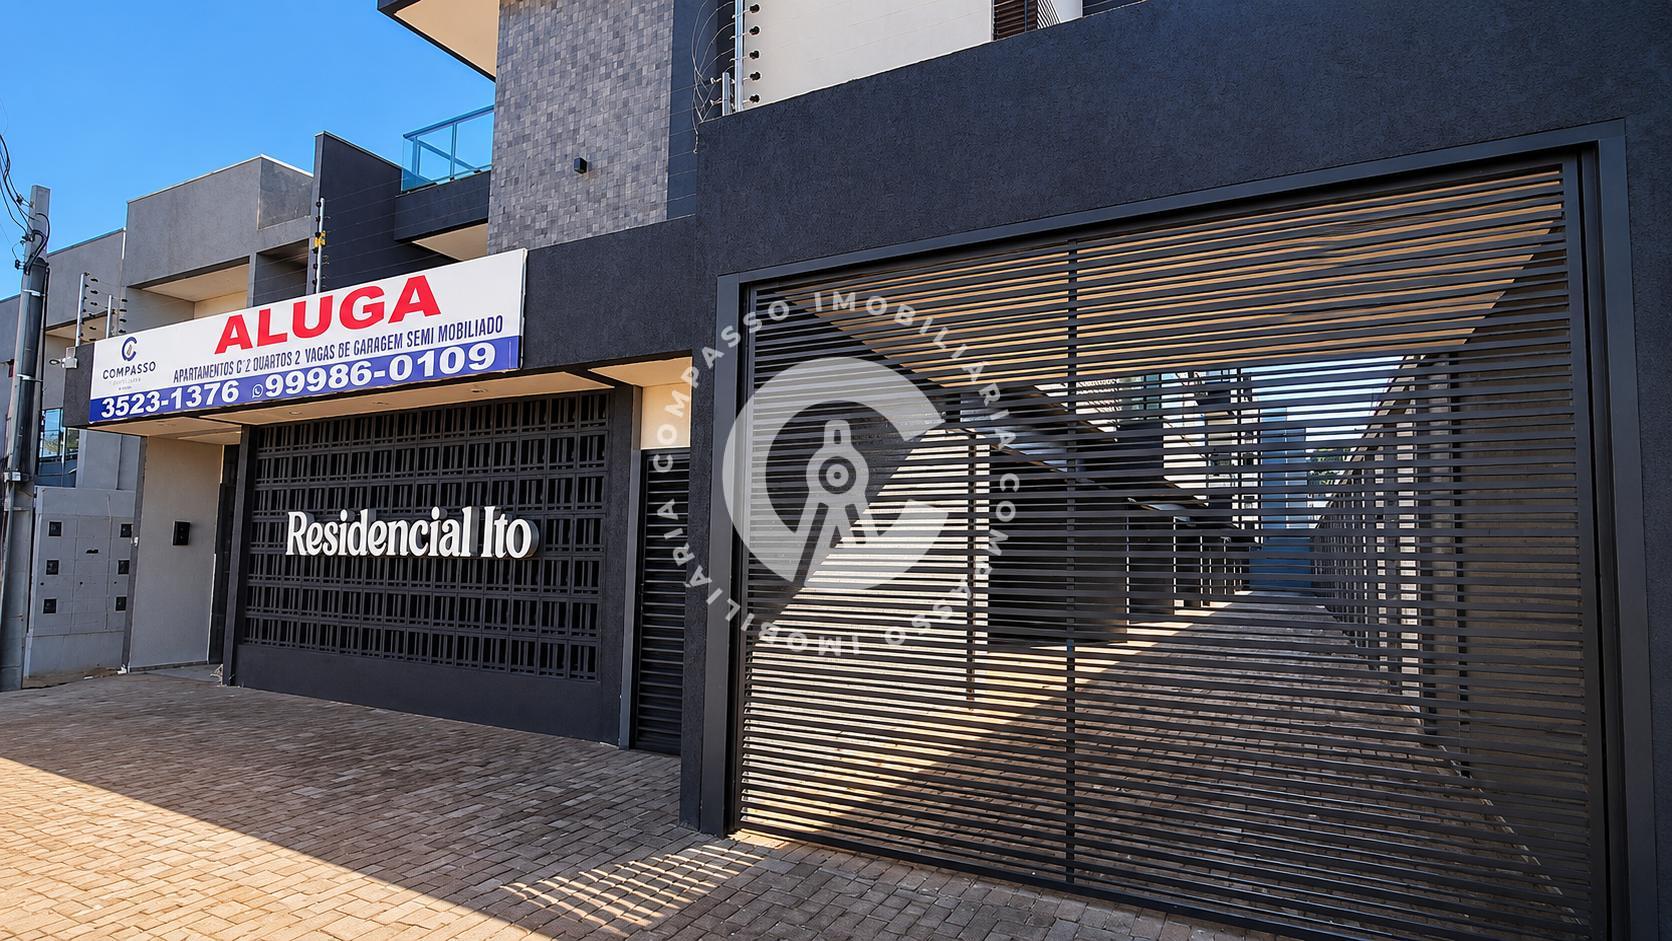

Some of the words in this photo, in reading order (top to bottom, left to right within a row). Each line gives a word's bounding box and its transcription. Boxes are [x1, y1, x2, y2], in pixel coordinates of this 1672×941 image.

[214, 274, 441, 355] ALUGA
[101, 380, 240, 419] 3523-1376
[265, 342, 496, 397] 99986-0109
[102, 361, 156, 380] COMPASSO
[173, 361, 233, 384] APARTAMENTOS
[294, 350, 301, 365] 2
[305, 344, 336, 363] VAGAS
[353, 333, 403, 356] GARAGEM
[406, 327, 434, 348] SEMI
[438, 315, 503, 343] MOBILIADO
[285, 506, 472, 558] Residencial
